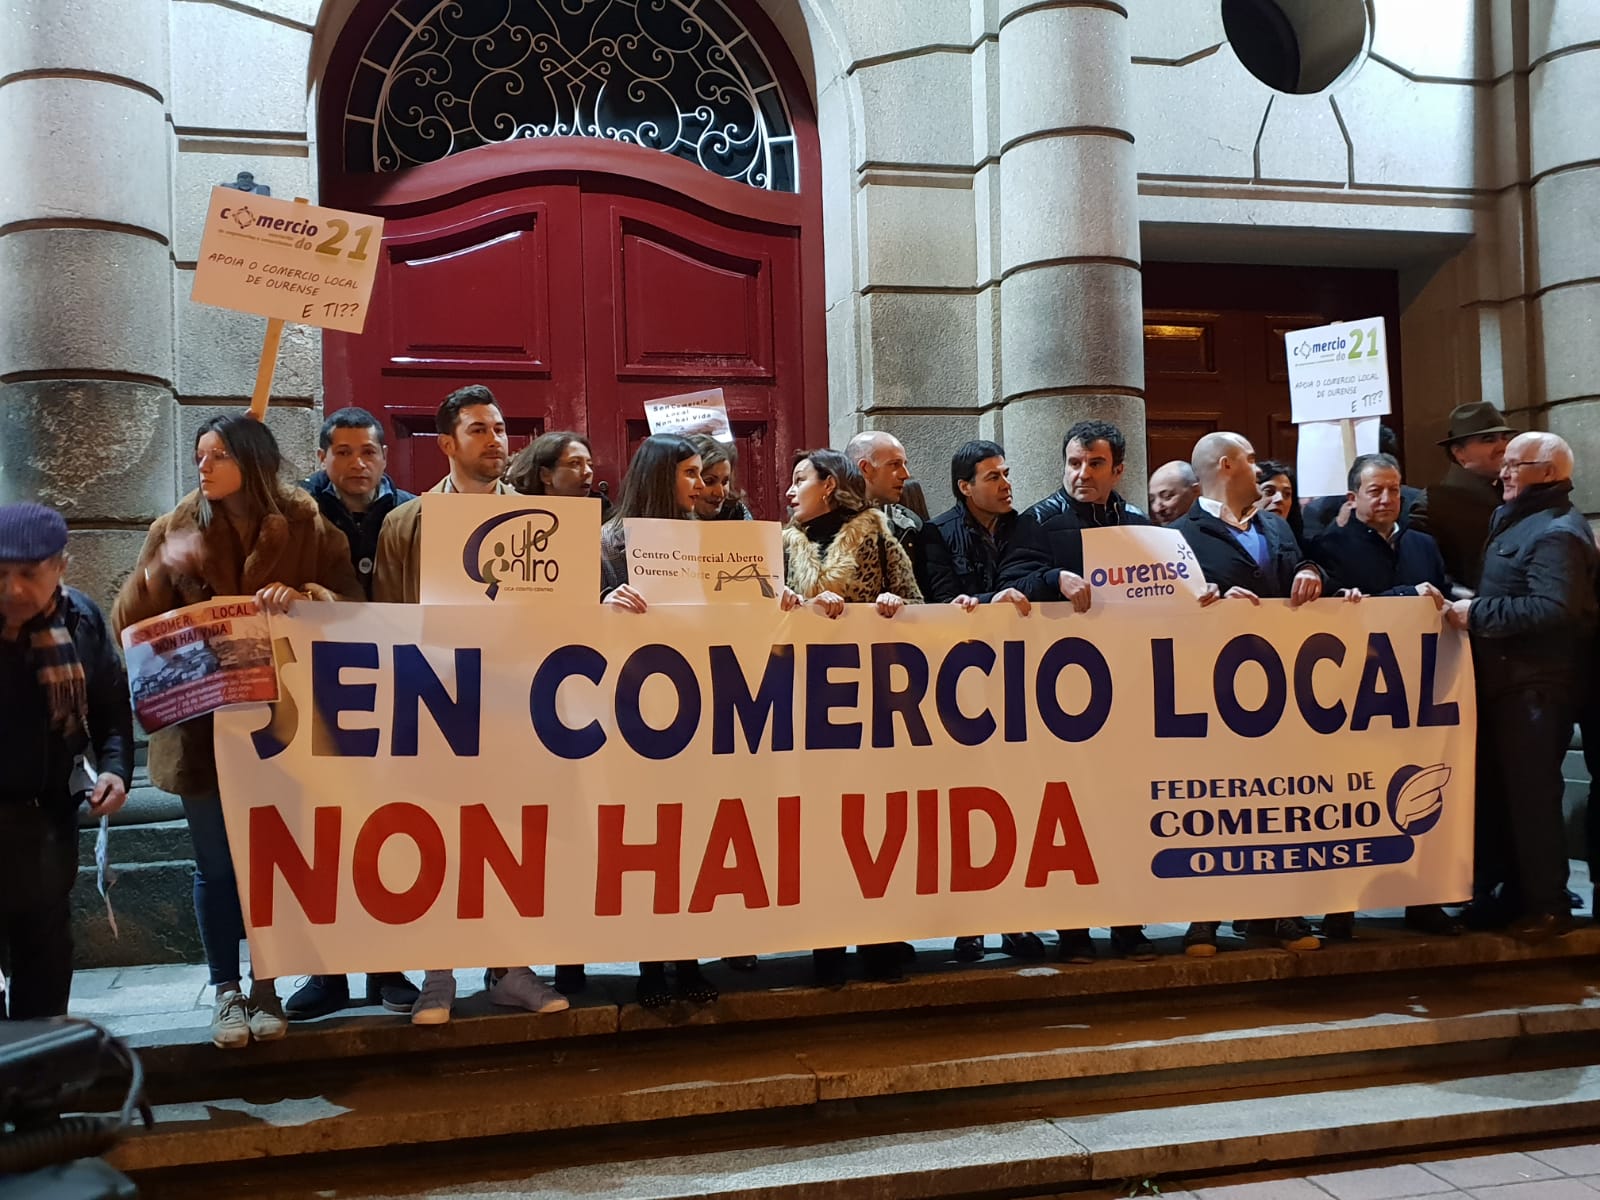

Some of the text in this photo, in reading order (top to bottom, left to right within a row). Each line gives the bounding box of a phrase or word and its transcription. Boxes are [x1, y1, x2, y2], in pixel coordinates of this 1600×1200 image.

[294, 237, 312, 251] do
[315, 218, 373, 261] 21
[208, 253, 358, 289] APOIA O COMERCIO LOCAL
[246, 274, 320, 296] DE OURENSE
[302, 302, 360, 318] E TI??
[1336, 352, 1346, 361] do
[1348, 326, 1379, 360] 21
[1323, 375, 1356, 386] COMERCIO
[1358, 373, 1380, 382] LOCAL
[1317, 386, 1357, 398] DE OURENSE
[1351, 400, 1357, 413] E
[632, 549, 764, 563] Centro Comercial Aberto
[633, 565, 679, 577] Ourense
[1090, 561, 1190, 587] ourense
[1126, 583, 1175, 599] centro
[212, 604, 251, 619] LOCAL
[201, 623, 228, 639] VIDA
[530, 637, 1113, 760] COMERCIO
[1151, 633, 1460, 738] LOCAL
[1151, 771, 1376, 800] FEDERACION DE
[1150, 801, 1381, 838] COMERCIO
[249, 781, 1100, 928] NON HAI VIDA
[1189, 842, 1373, 873] OURENSE
